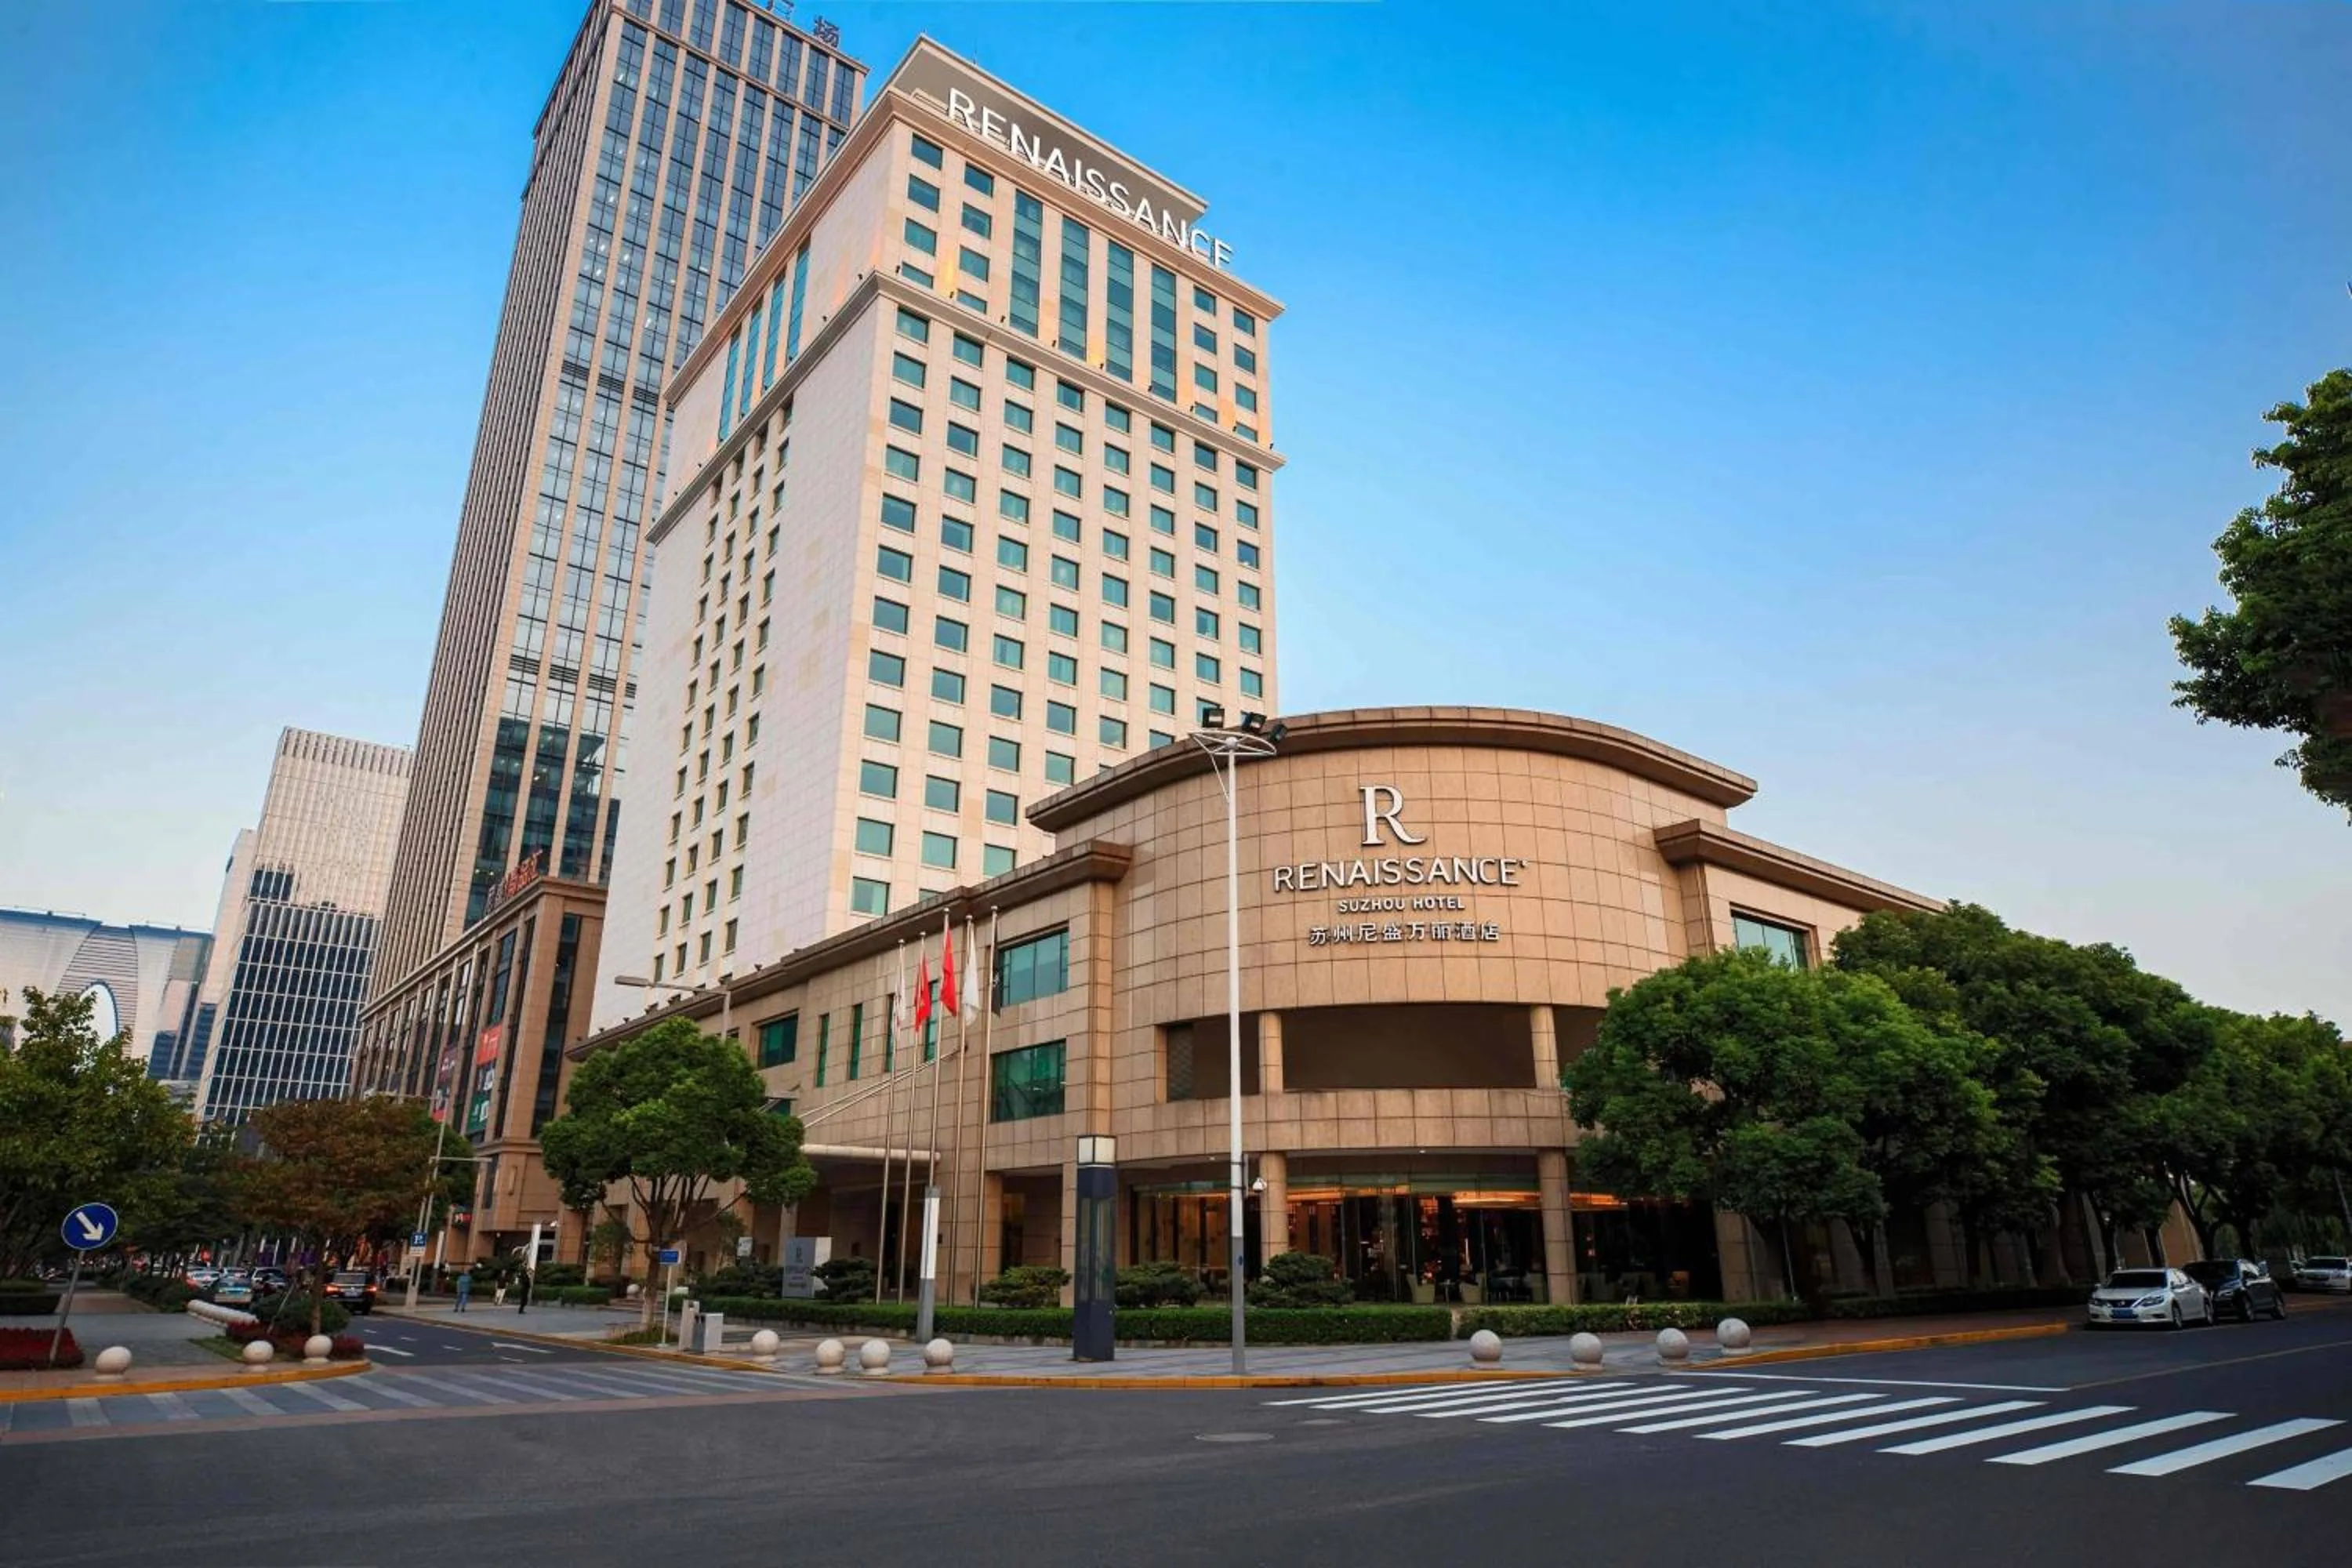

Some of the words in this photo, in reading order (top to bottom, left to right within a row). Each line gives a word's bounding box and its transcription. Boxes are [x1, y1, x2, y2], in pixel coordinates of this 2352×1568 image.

[947, 87, 1234, 267] RENAISSANCE
[1359, 785, 1428, 845] R
[1274, 857, 1519, 893] RENAISSANCE
[1338, 898, 1405, 913] SUZHOU
[1414, 895, 1465, 909] HOTEL
[1309, 920, 1501, 946] 苏州尼盛万丽酒店
